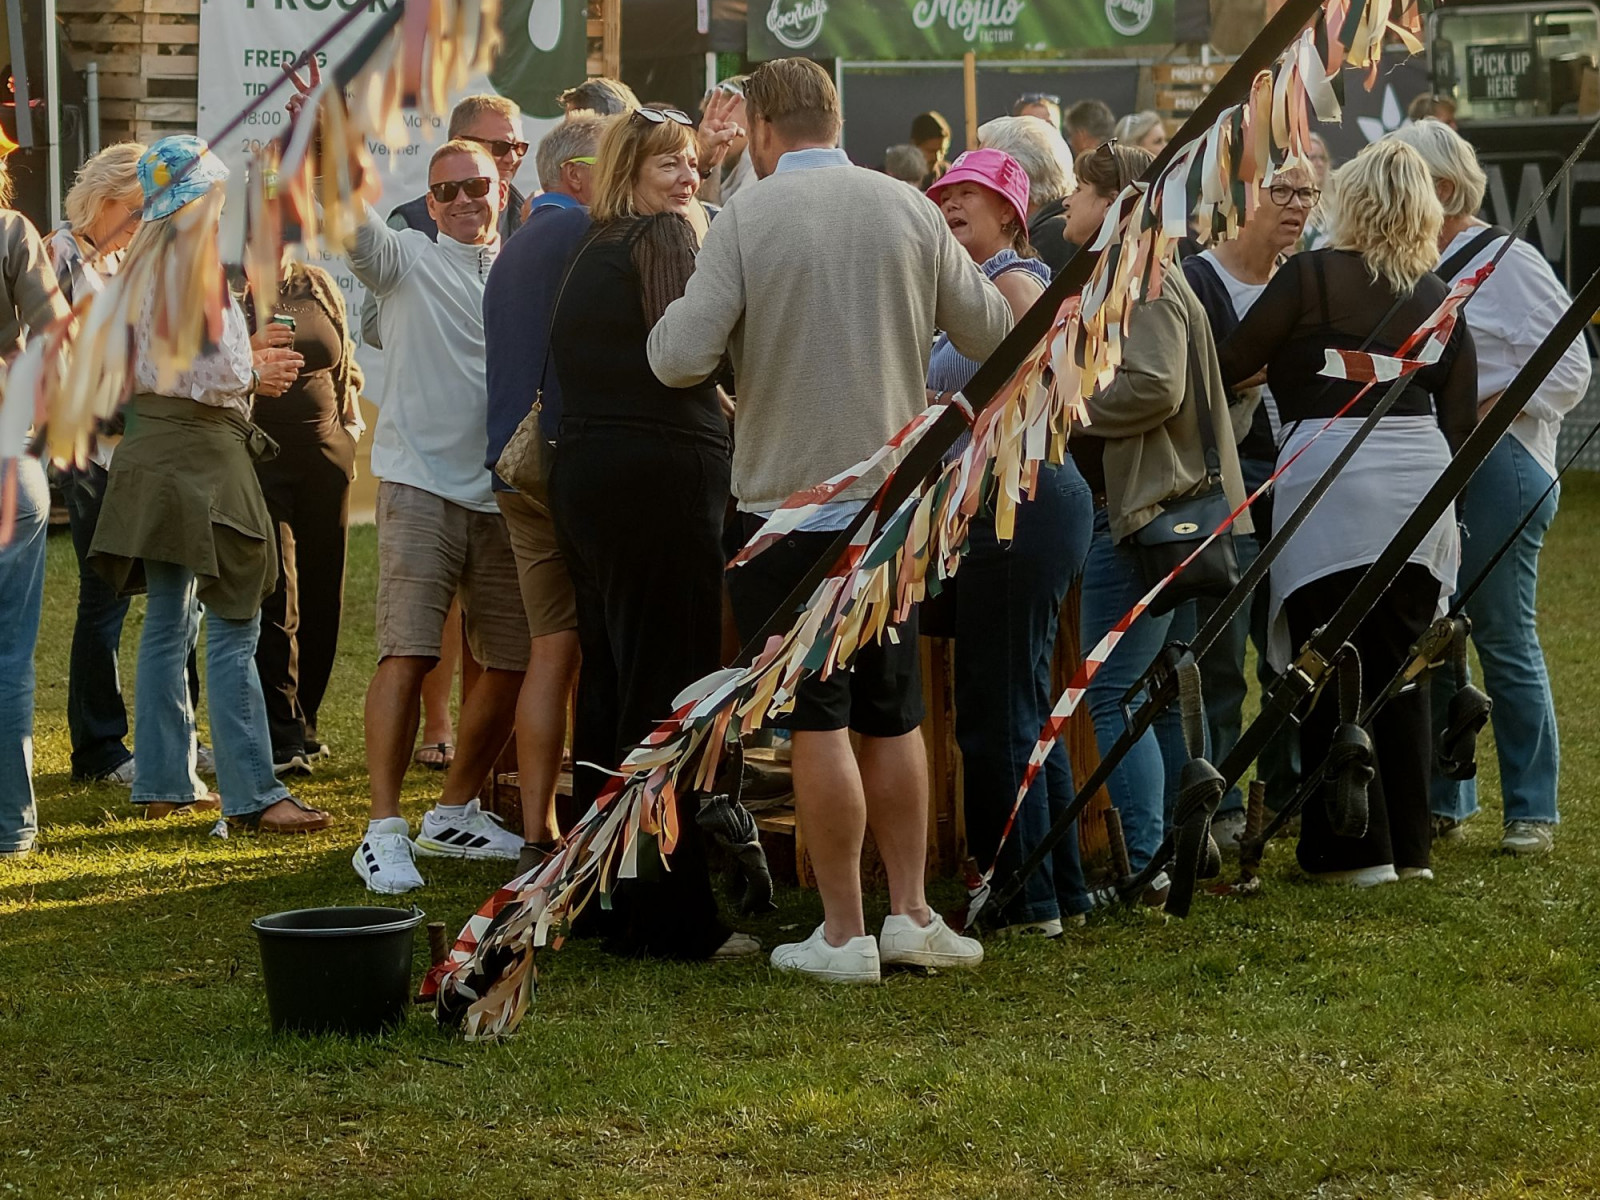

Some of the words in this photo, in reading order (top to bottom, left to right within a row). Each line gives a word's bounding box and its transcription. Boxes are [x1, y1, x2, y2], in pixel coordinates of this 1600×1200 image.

[980, 30, 1014, 44] FACTORY
[1473, 52, 1507, 76] PICK
[1511, 51, 1531, 75] UP
[1486, 76, 1517, 98] HERE
